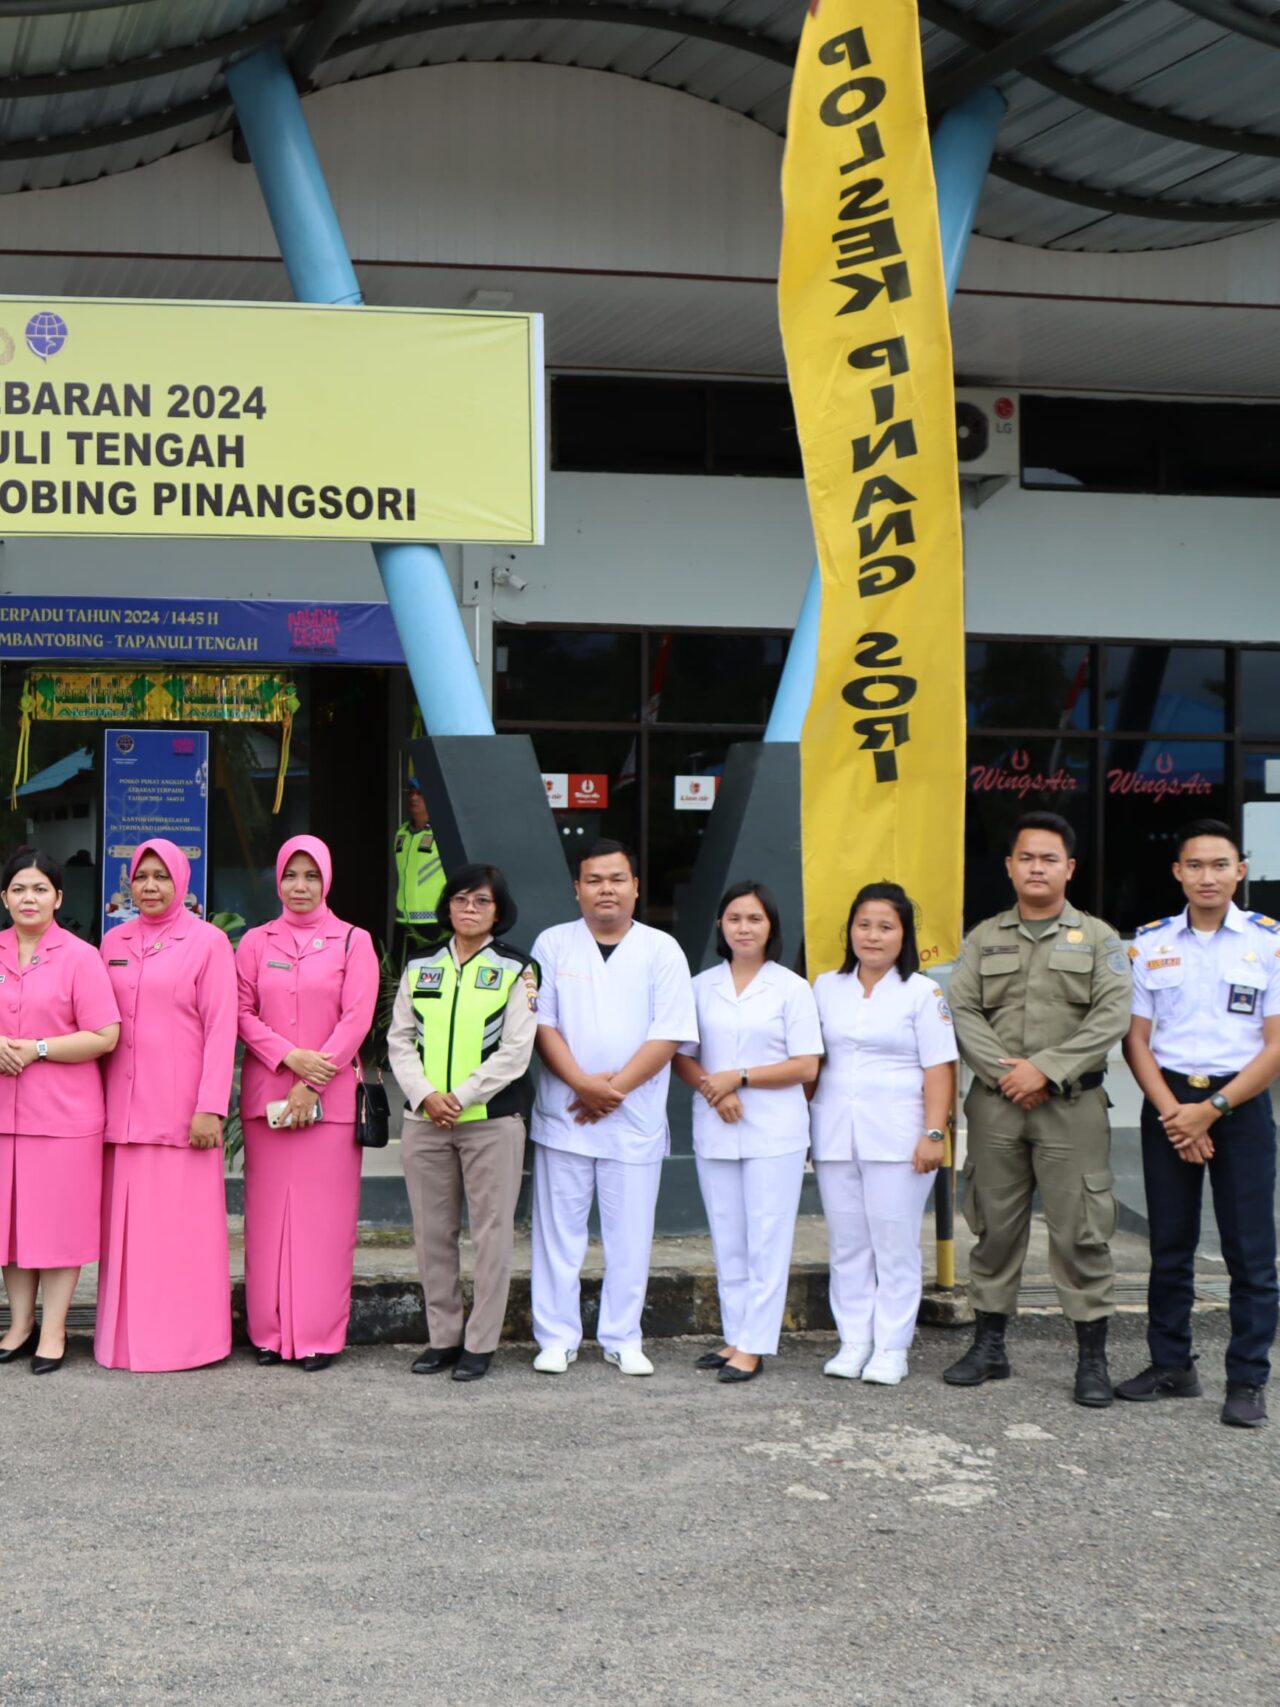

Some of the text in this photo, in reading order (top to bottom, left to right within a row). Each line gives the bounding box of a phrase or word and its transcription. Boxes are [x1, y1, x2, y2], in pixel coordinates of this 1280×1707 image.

[167, 384, 267, 420] 2024
[996, 423, 1012, 434] LG
[66, 431, 244, 469] TENGAH
[153, 482, 416, 521] PINANGSORI
[66, 609, 121, 623] TAHUN
[124, 610, 160, 624] 2024
[208, 612, 219, 625] H
[115, 635, 193, 649] TAPANULI
[195, 637, 259, 651] TENGAH
